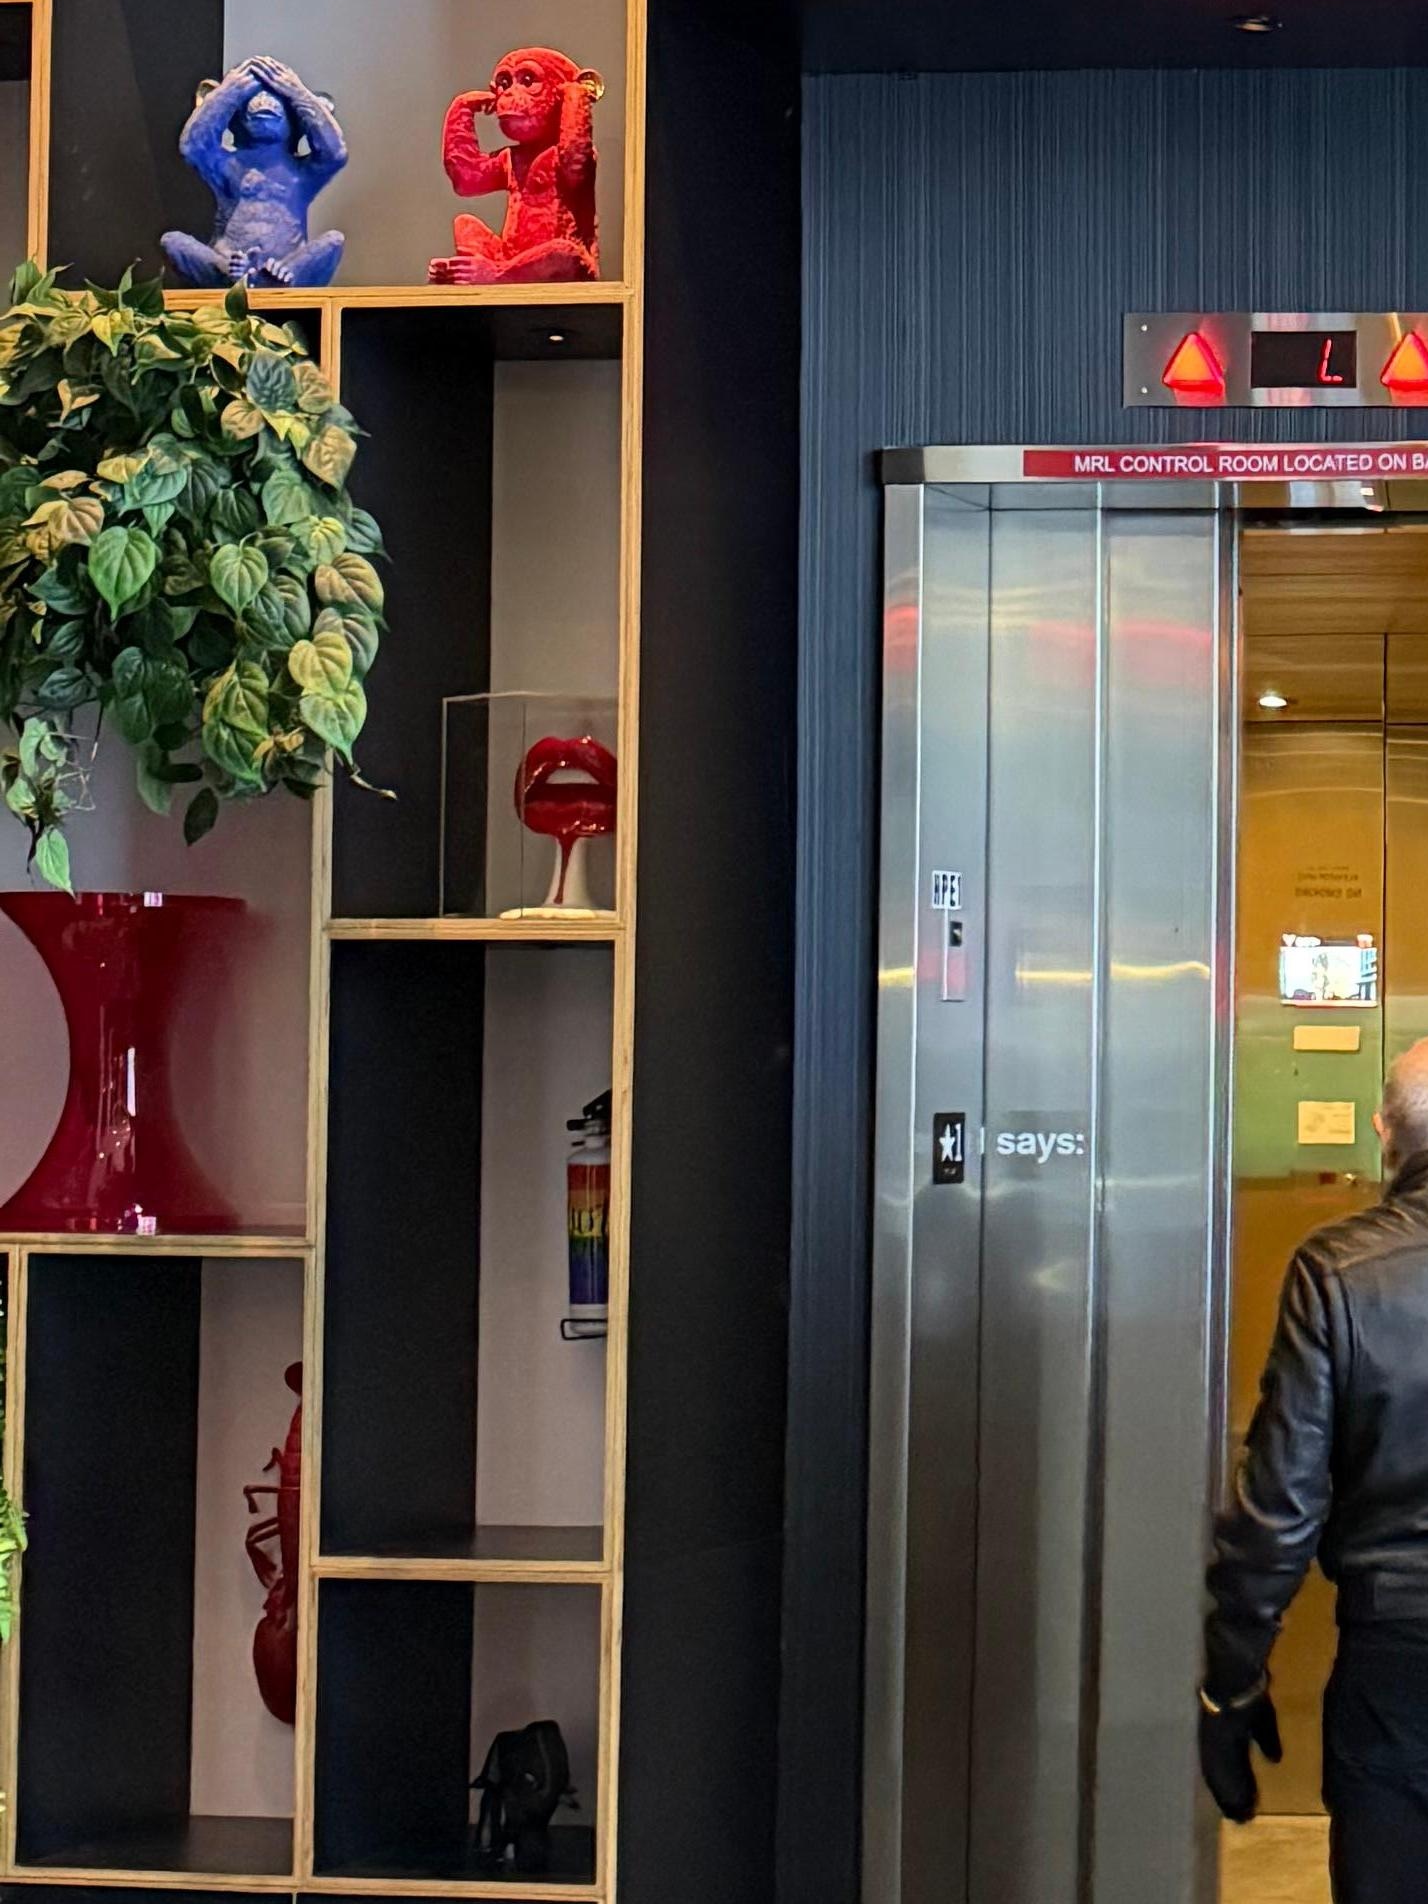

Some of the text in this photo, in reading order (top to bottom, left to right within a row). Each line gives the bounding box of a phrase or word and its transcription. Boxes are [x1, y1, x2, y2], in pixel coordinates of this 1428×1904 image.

[1319, 339, 1343, 384] L
[1074, 456, 1114, 473] MRL
[1119, 455, 1214, 473] CONTROL
[1219, 455, 1278, 472] ROOM
[1283, 454, 1372, 472] LOCATED
[1378, 454, 1407, 471] ON
[997, 1132, 1085, 1164] says:
